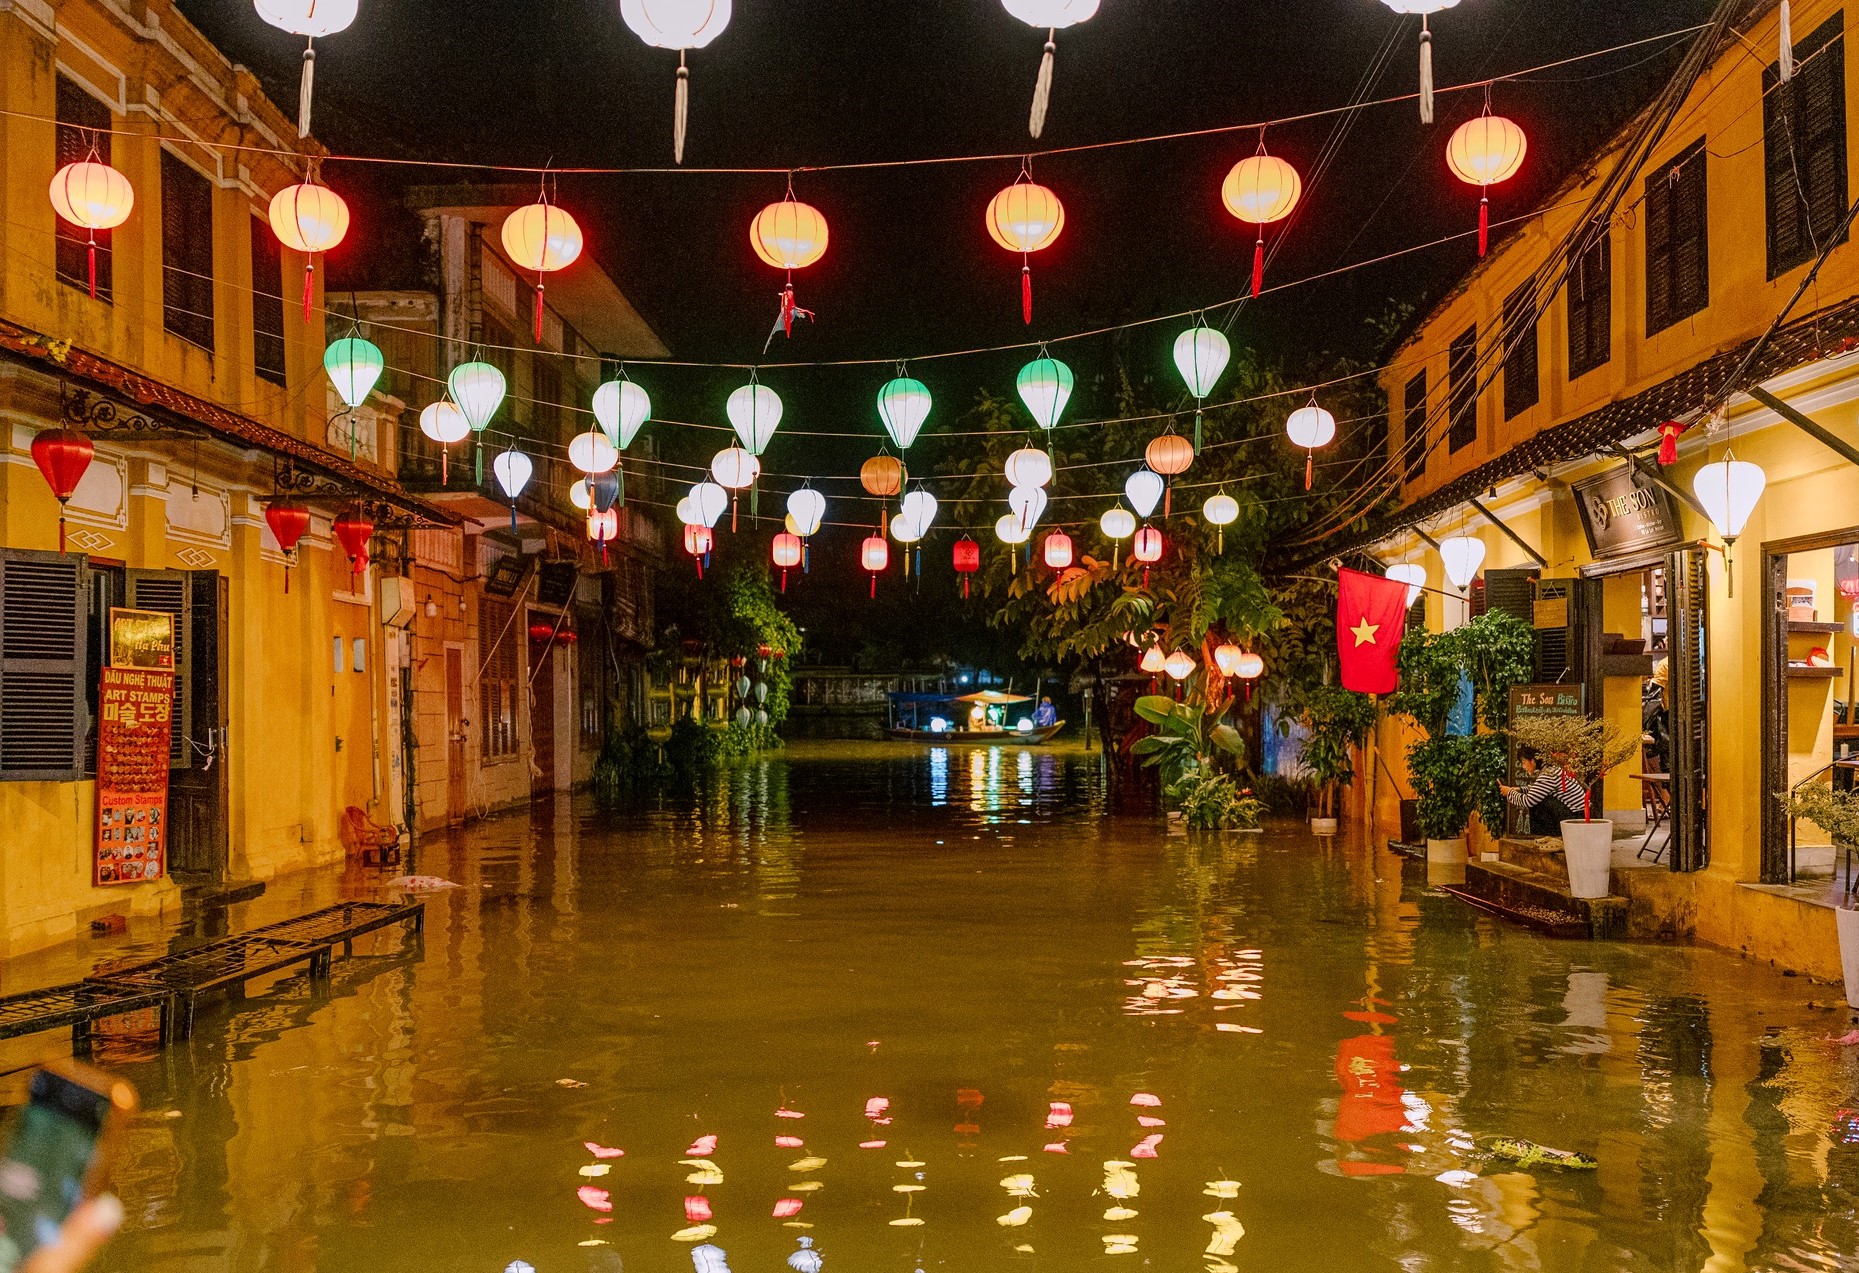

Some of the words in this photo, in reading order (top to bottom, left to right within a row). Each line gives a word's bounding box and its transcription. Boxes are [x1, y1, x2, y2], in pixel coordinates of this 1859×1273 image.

[1607, 496, 1630, 517] THE
[1630, 488, 1656, 511] SON
[124, 672, 145, 688] NGHỆ
[147, 674, 172, 690] THUẬT
[106, 689, 127, 701] ART
[130, 691, 170, 703] STAMPS
[1521, 693, 1536, 705] The
[1539, 692, 1554, 705] Son
[104, 703, 136, 722] 미술
[139, 703, 170, 722] 도장
[103, 796, 132, 805] Custom
[135, 795, 162, 806] Stamps
